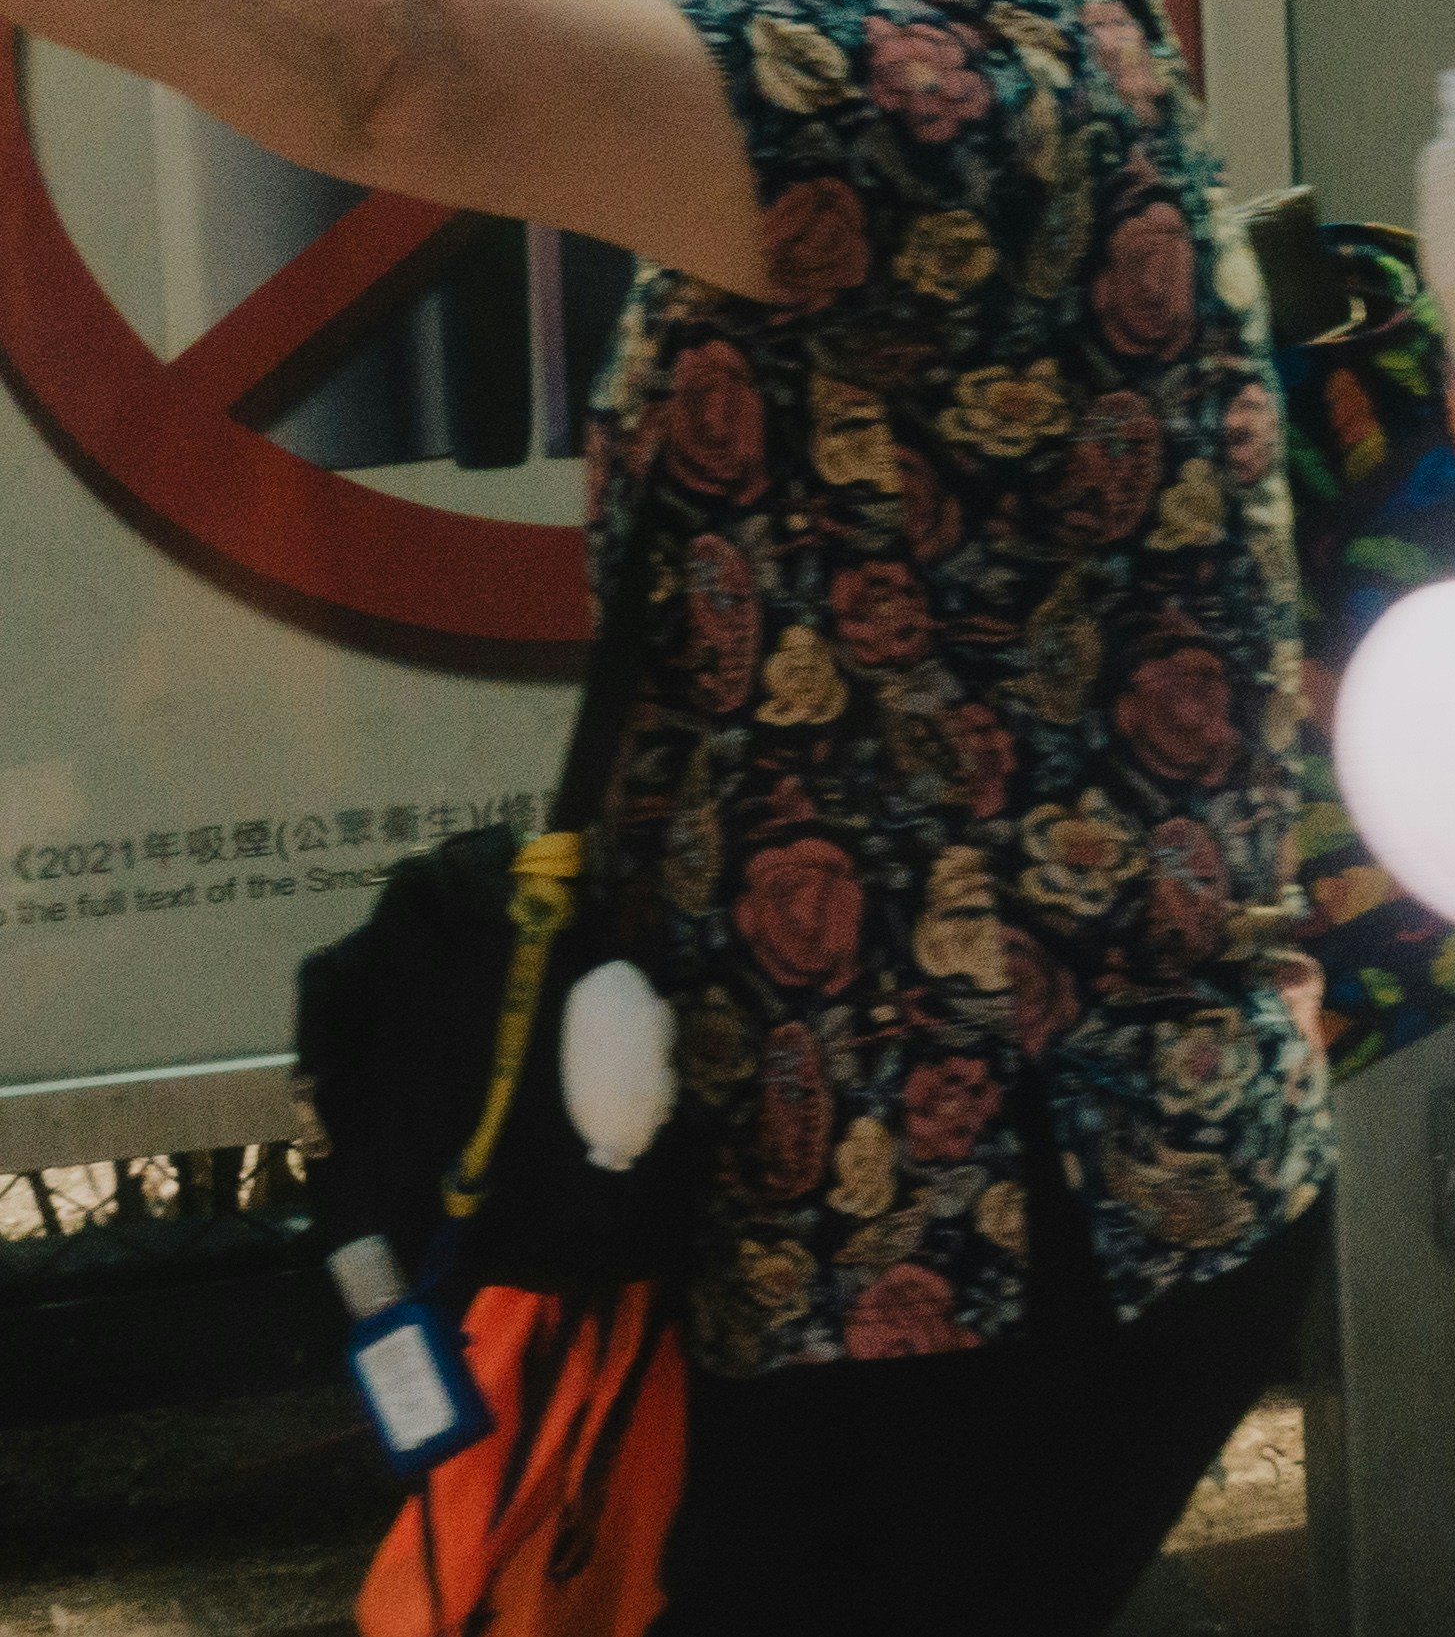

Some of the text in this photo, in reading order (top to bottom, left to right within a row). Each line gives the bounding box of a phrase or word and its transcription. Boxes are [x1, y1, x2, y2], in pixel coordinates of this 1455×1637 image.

[17, 896, 68, 926] the
[76, 890, 127, 921] full
[135, 883, 199, 915] text
[206, 875, 238, 905] of
[246, 871, 297, 899] the
